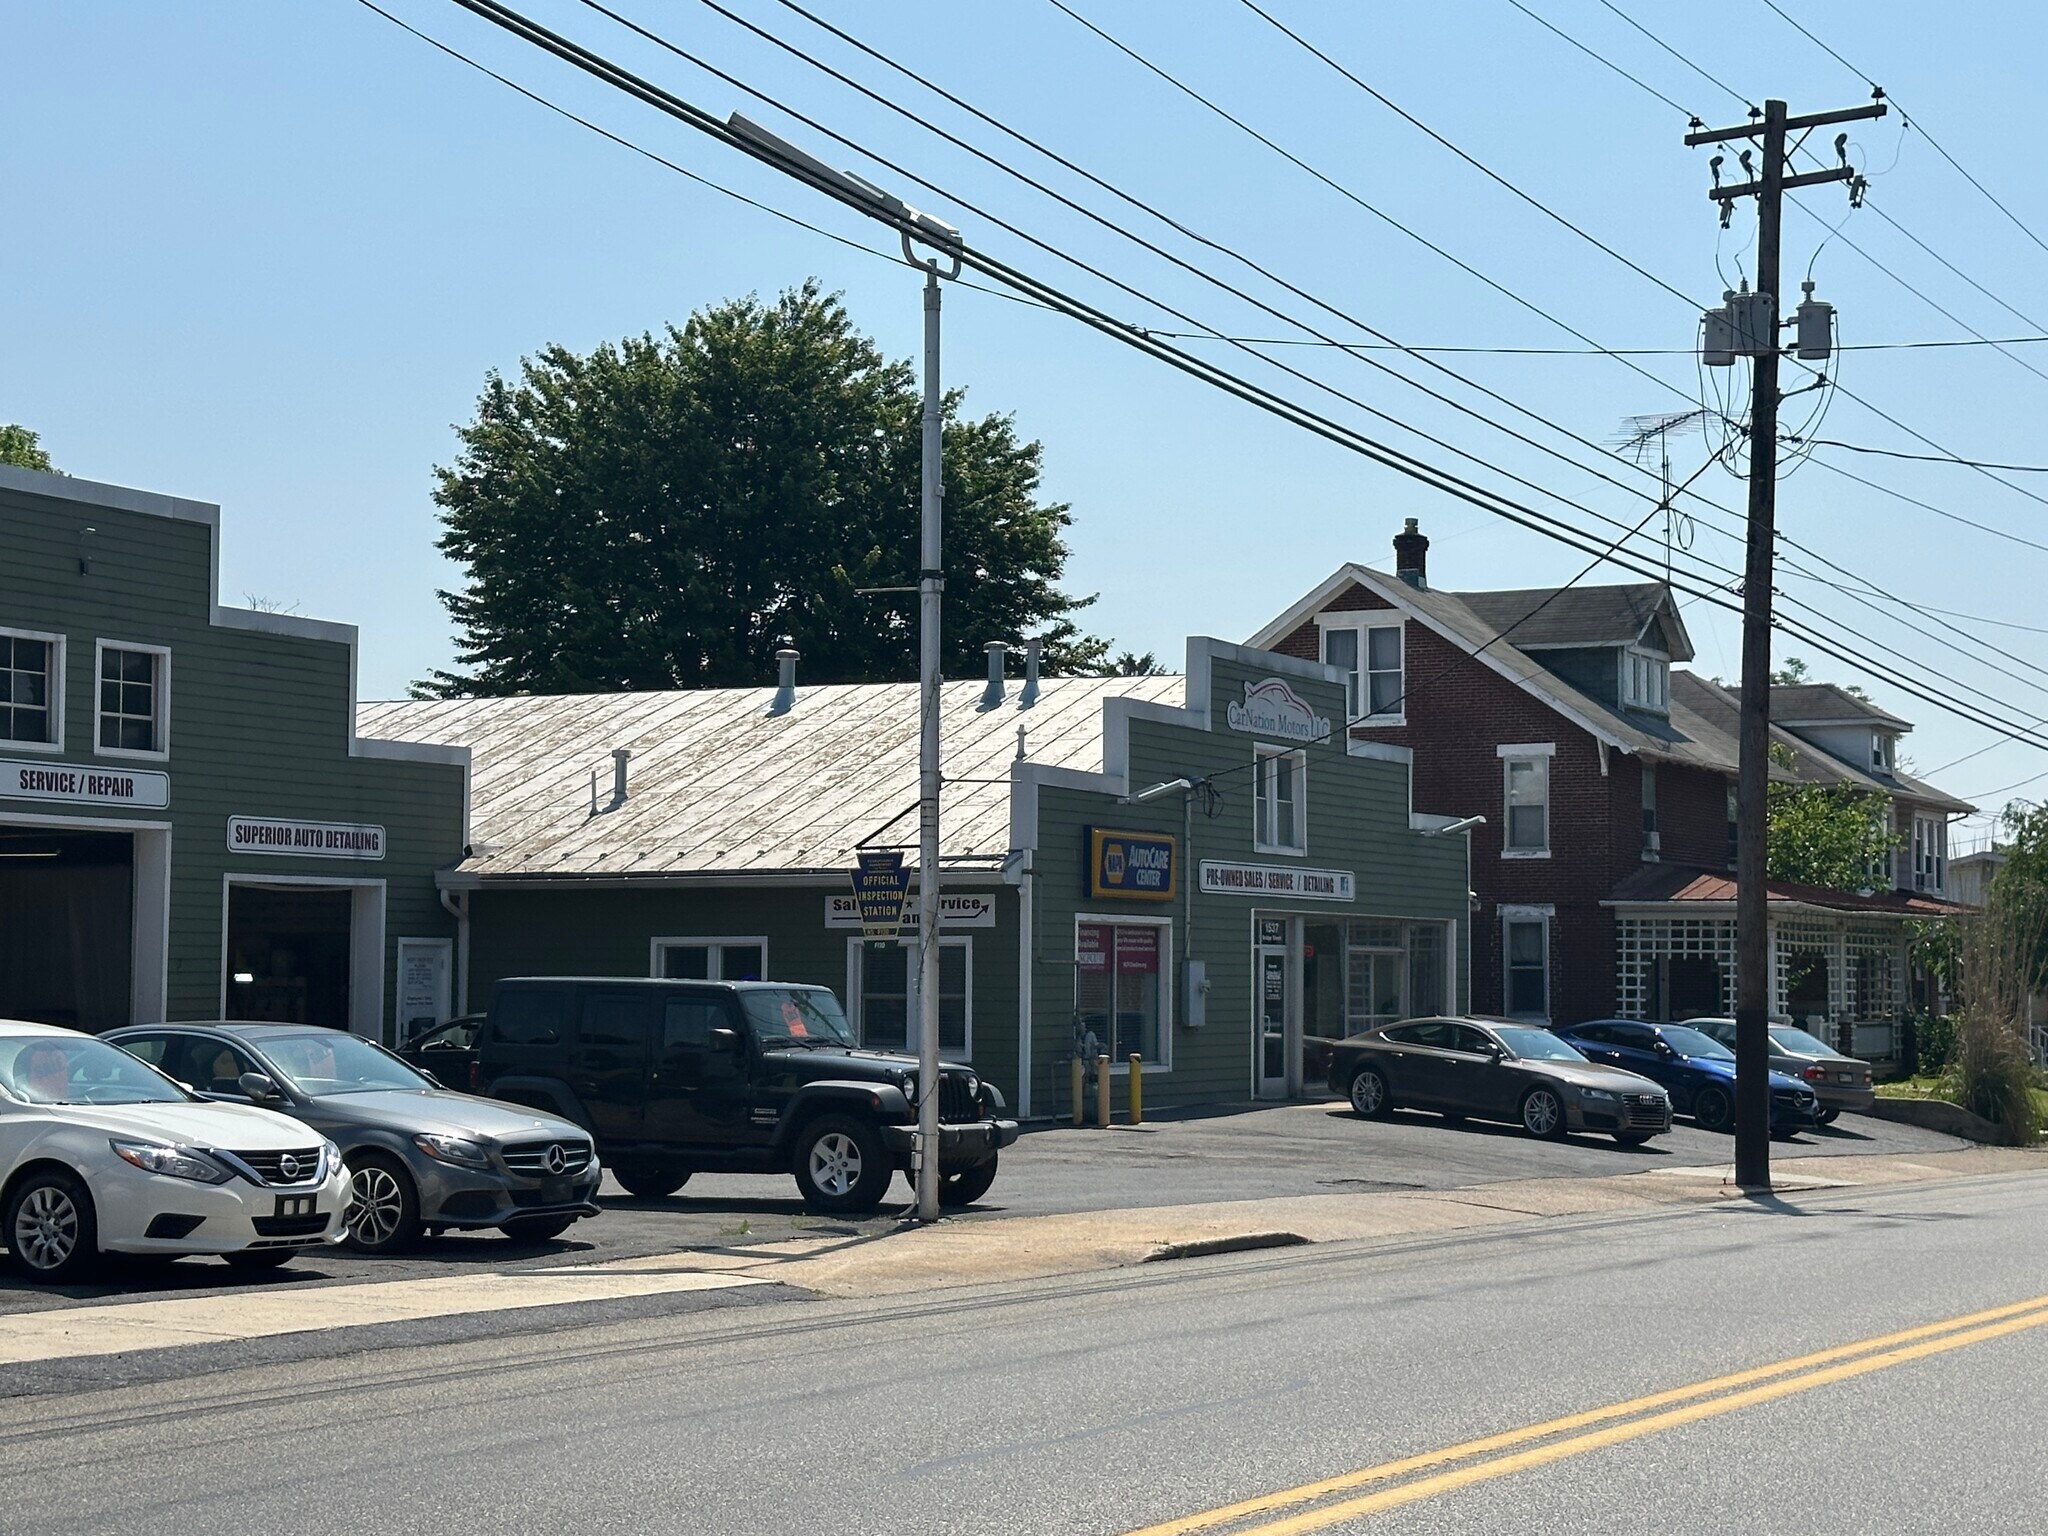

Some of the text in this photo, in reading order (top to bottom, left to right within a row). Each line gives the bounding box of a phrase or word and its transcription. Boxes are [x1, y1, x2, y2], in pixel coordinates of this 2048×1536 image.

[1229, 705, 1276, 731] CarNation
[1278, 714, 1309, 738] Motors
[20, 769, 76, 793] SERVICE
[88, 775, 133, 797] REPAIR
[235, 824, 379, 850] SUPERIOR AUTO DETAILING
[863, 876, 899, 886] OFFICIAL
[1136, 869, 1160, 886] CENTER
[1206, 868, 1243, 888] PRE-OWNED
[1244, 870, 1263, 888] SALES
[1268, 872, 1293, 890] SERVICE
[1303, 875, 1334, 894] DETAILING
[858, 890, 903, 901] INSPECTION
[863, 905, 897, 916] STATION
[902, 912, 920, 924] an
[1265, 922, 1279, 933] 1537
